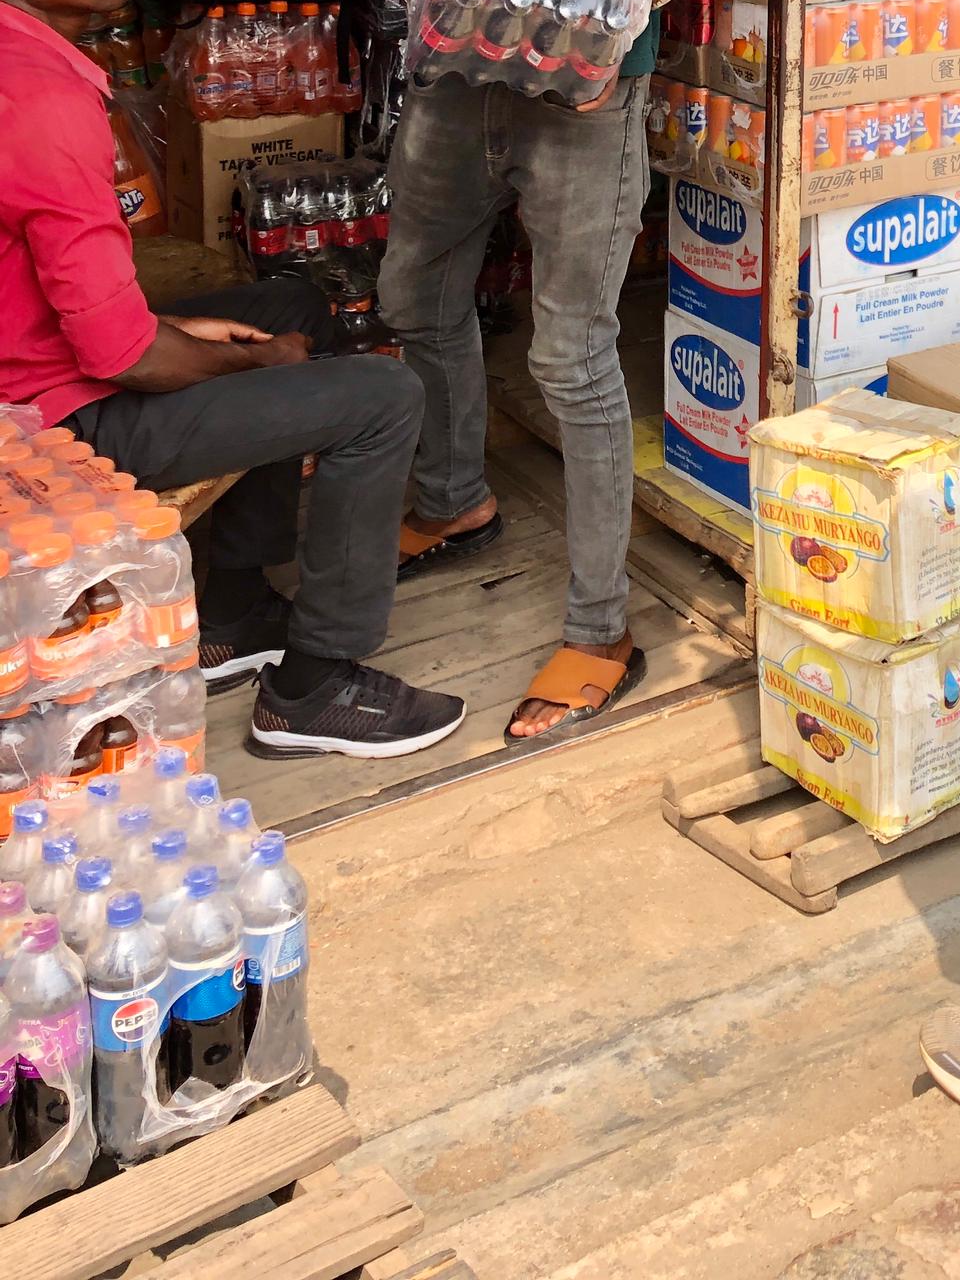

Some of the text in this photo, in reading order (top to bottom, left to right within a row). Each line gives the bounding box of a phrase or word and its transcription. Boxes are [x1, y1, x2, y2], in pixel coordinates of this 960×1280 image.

[252, 139, 293, 154] WHITE
[219, 156, 262, 172] TAE
[678, 184, 743, 234] supalait
[853, 198, 958, 263] supalait
[855, 287, 950, 312] Full Cream Milk Powder
[859, 299, 945, 323] Lait Entier En Poudre
[674, 345, 741, 403] supalait
[813, 514, 881, 552] MURYANGO
[813, 695, 874, 745] MURYANGO
[115, 1010, 156, 1028] PEPSI
